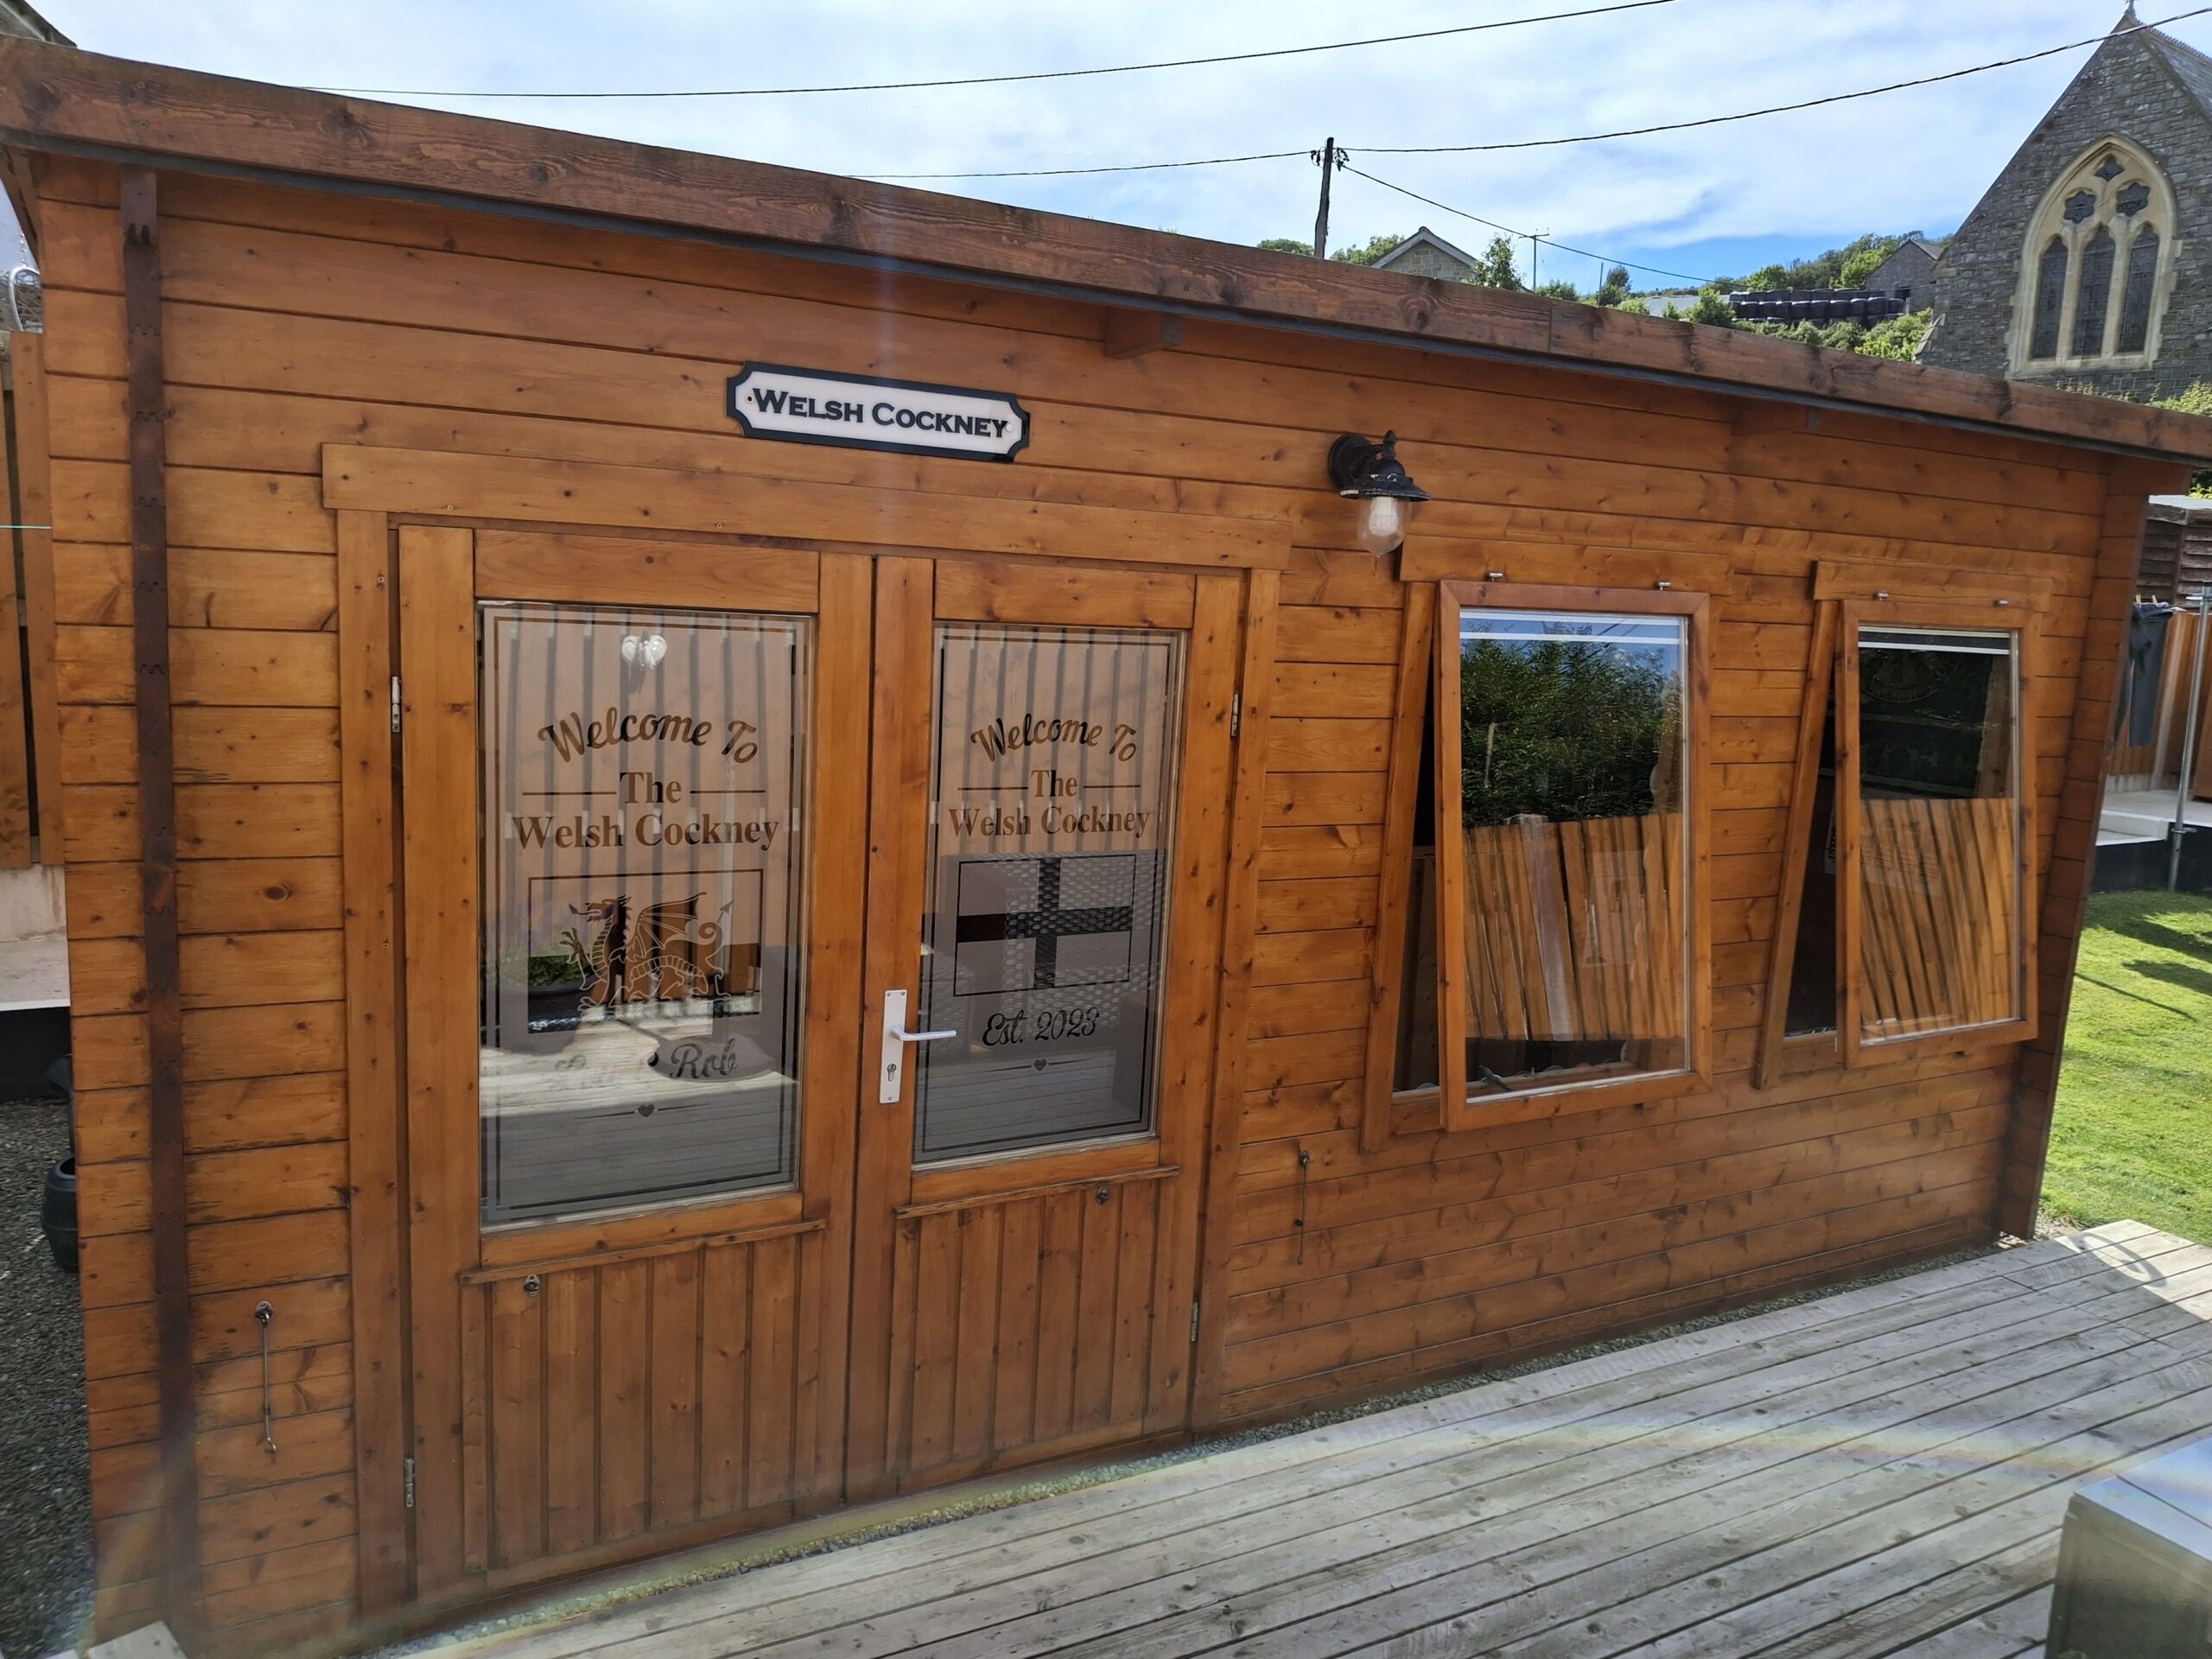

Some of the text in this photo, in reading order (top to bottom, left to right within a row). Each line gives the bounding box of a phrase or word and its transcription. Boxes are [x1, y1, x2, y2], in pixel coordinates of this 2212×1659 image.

[752, 387, 1010, 438] WELSH COCKNEY
[537, 706, 759, 764] Welcome To
[969, 713, 1137, 762] Welcome To
[620, 772, 682, 804] The
[1031, 769, 1078, 798] The
[512, 813, 780, 851] Welsh Cockney
[948, 804, 1152, 839] Welsh Cockney
[982, 1006, 1100, 1046] Est. 2023
[669, 1037, 740, 1079] Rob
